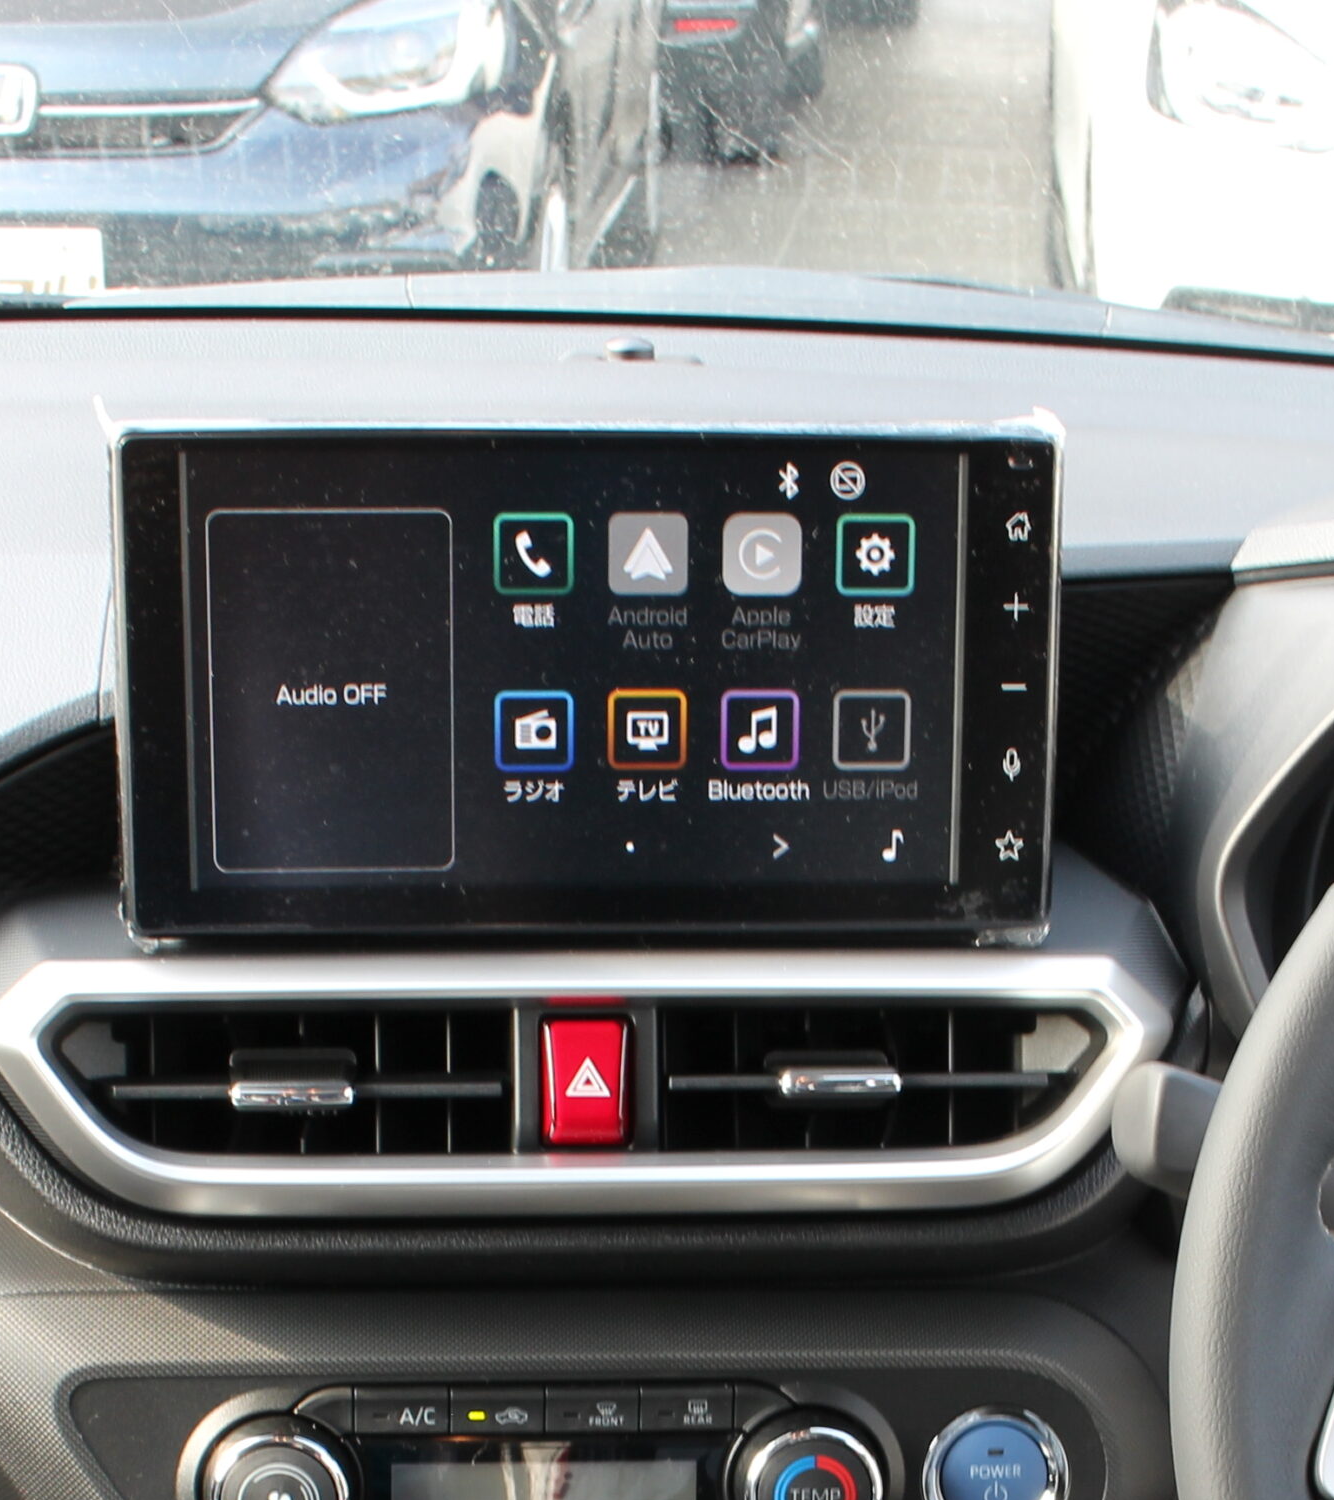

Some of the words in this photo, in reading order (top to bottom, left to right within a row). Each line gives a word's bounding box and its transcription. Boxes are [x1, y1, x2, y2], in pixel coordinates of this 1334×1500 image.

[511, 603, 555, 629] 電話
[607, 605, 688, 627] Android
[731, 605, 791, 630] Apple
[853, 603, 896, 629] 設定
[622, 629, 673, 650] Auto
[720, 629, 802, 653] CarPlay
[275, 684, 338, 706] Audio
[342, 683, 387, 706] OFF
[636, 719, 660, 737] TV
[503, 778, 565, 803] ラジオ
[615, 778, 679, 803] テレビ
[708, 778, 810, 802] Bluetooth
[822, 778, 918, 802] USB/iPod
[398, 1406, 437, 1428] A/C
[588, 1414, 625, 1427] FRONT
[683, 1411, 713, 1425] REAR
[968, 1462, 1023, 1480] POWER
